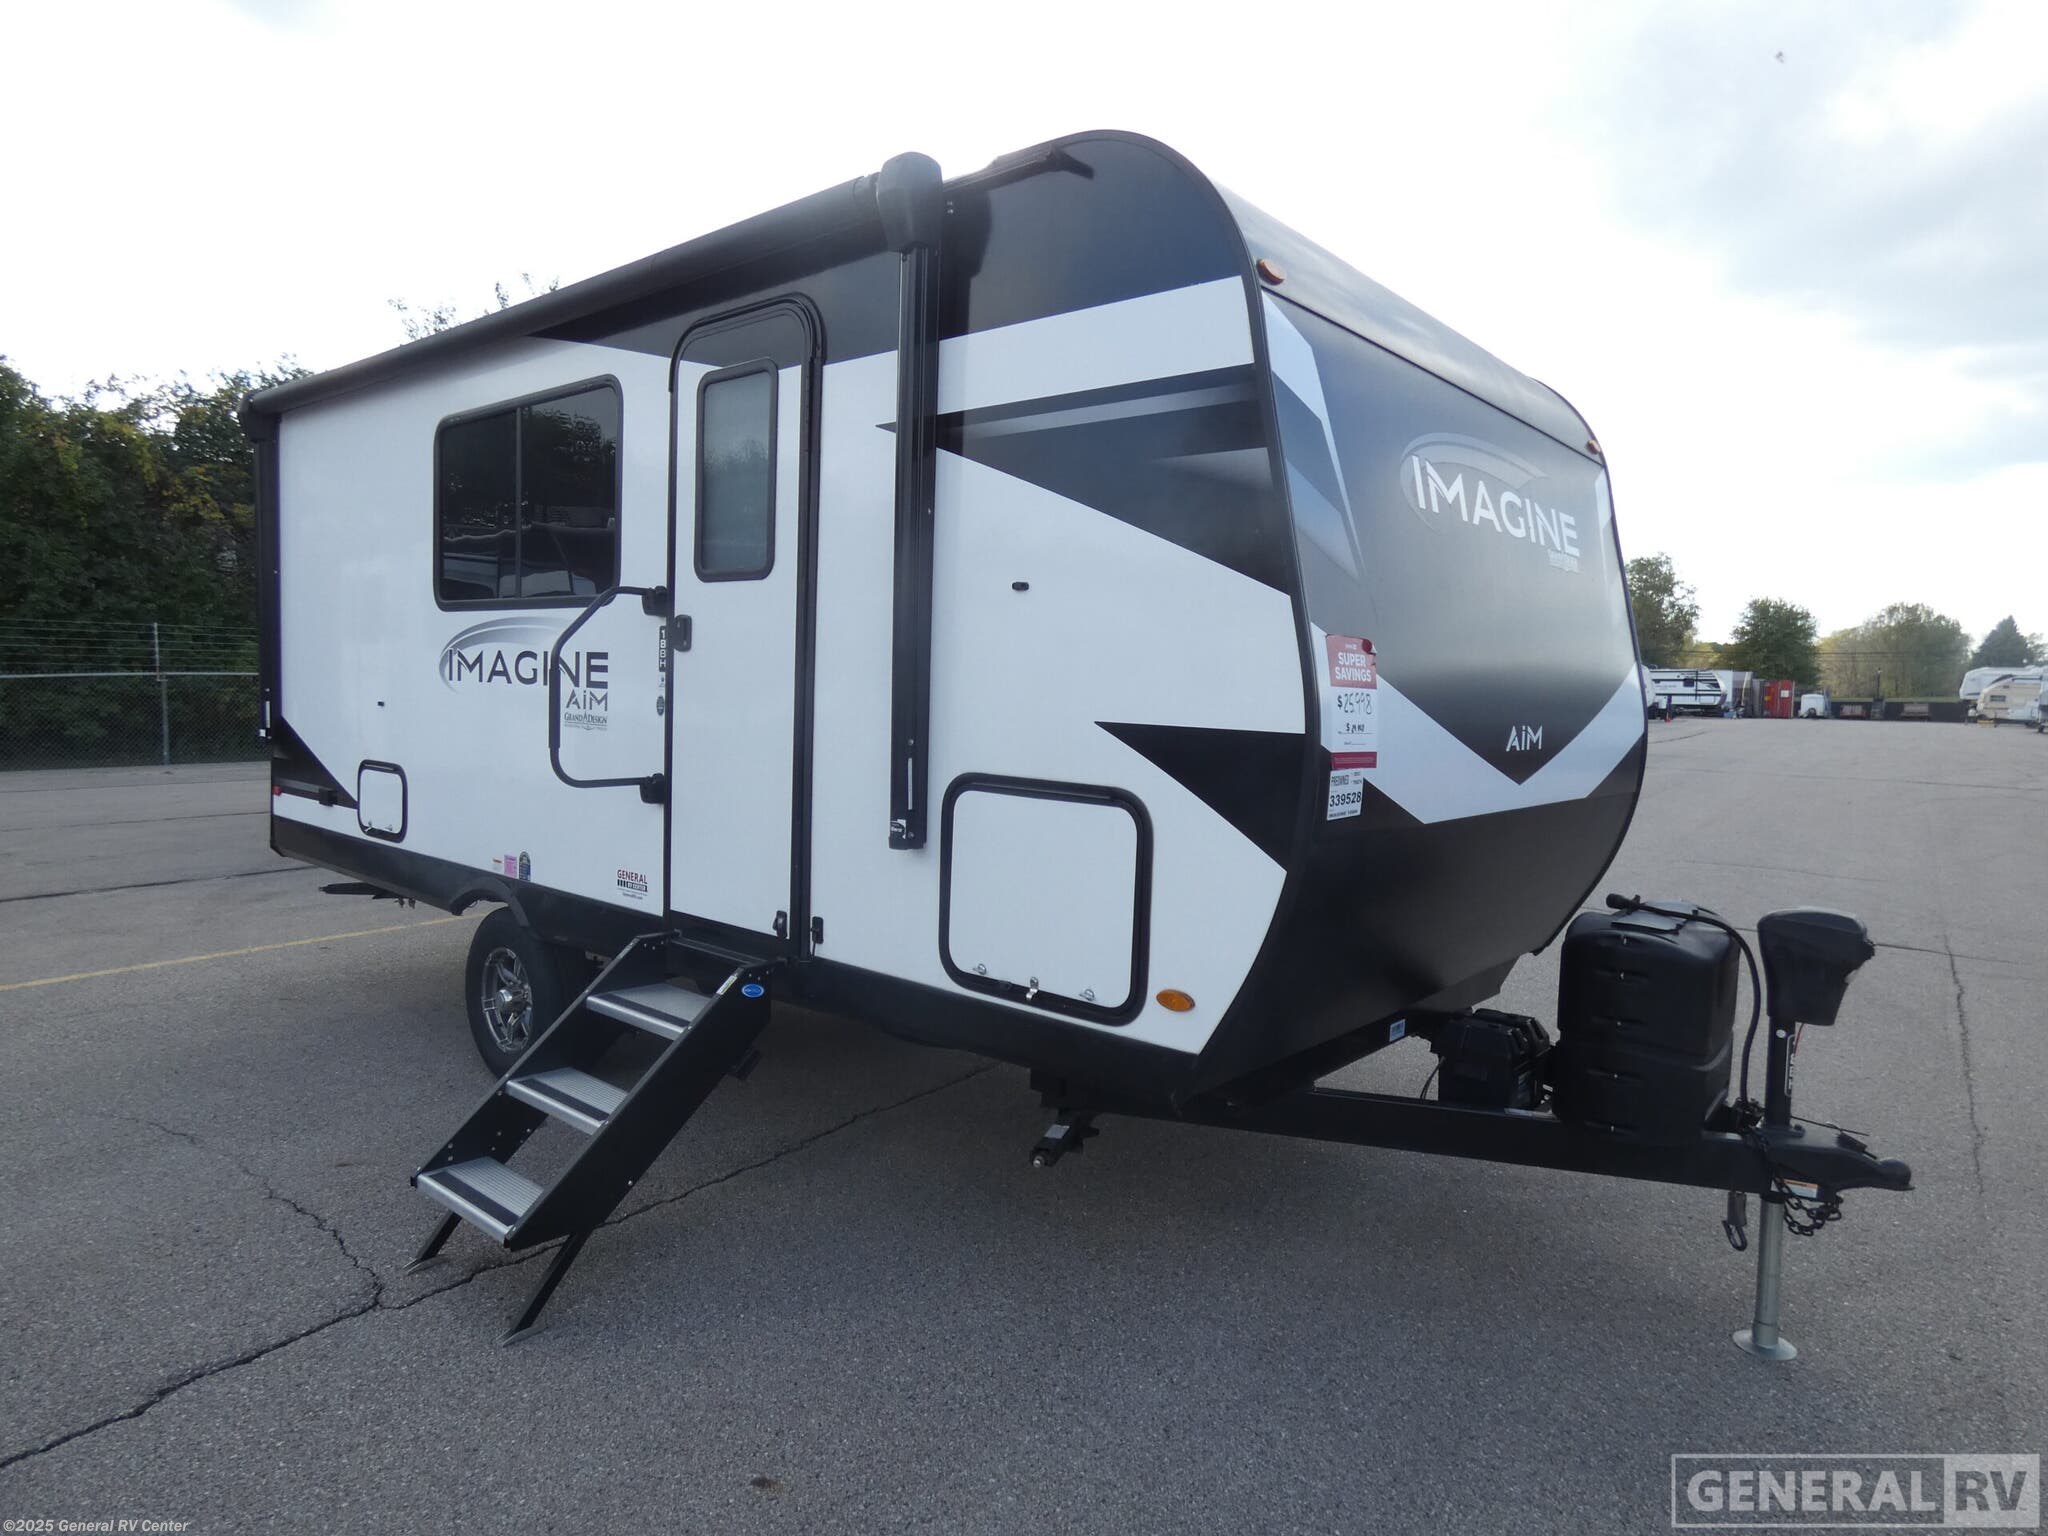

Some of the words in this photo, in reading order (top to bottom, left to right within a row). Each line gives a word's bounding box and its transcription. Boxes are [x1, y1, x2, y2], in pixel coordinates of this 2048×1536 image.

[1412, 455, 1580, 557] IMAGINE
[1337, 651, 1367, 667] SUPER
[448, 648, 609, 690] IMAGINE
[1335, 666, 1372, 683] SAVINGS
[1329, 791, 1362, 807] 339528
[617, 869, 649, 885] GENERAL
